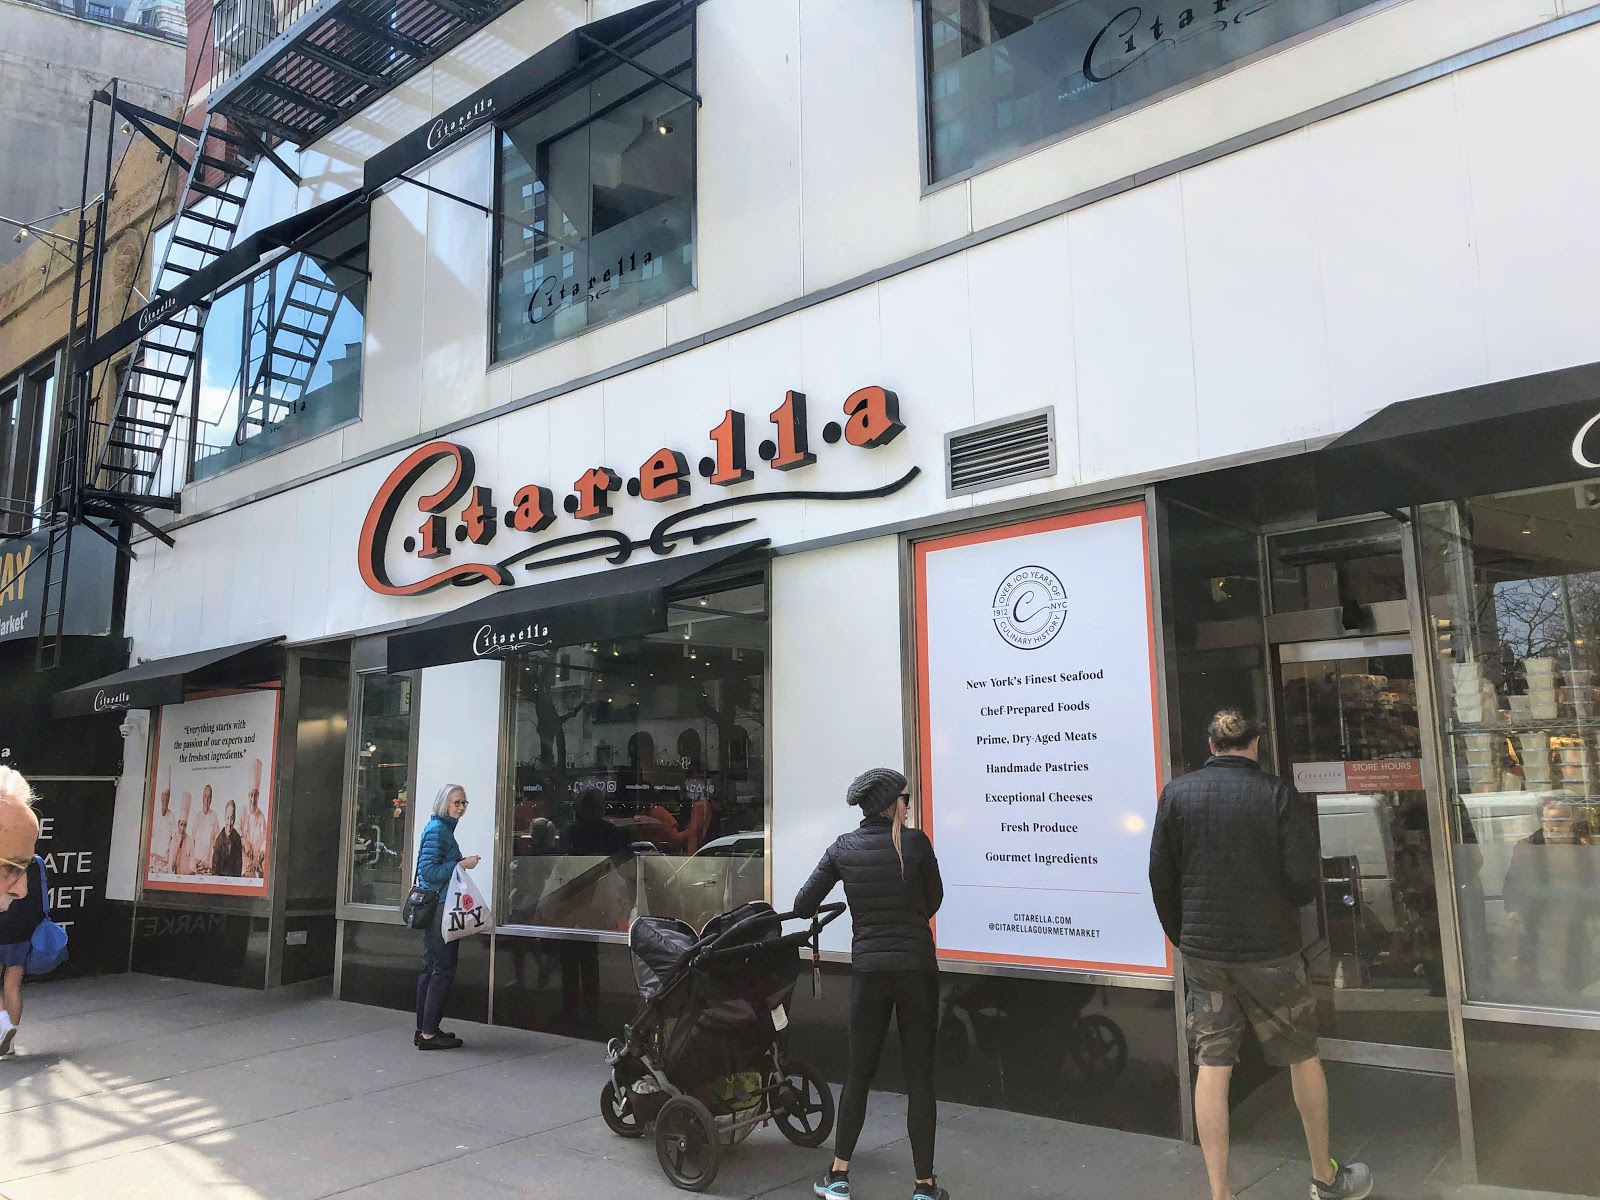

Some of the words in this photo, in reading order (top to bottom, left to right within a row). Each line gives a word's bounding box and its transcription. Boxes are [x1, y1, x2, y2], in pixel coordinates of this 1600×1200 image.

[427, 98, 494, 150] Citarella
[528, 250, 653, 324] Citarella
[0, 545, 32, 605] AY
[998, 582, 1013, 604] OVER
[1013, 571, 1028, 583] 100
[1030, 571, 1053, 587] YEARS
[1051, 585, 1061, 597] OF
[993, 608, 1008, 617] 1912
[1050, 601, 1068, 610] NYC
[1000, 621, 1033, 645] CULINARY
[1033, 614, 1061, 644] HISTORY
[473, 624, 549, 656] Citarella
[966, 680, 988, 690] New
[1024, 673, 1057, 685] Finest
[1059, 668, 1104, 683] Seafood
[980, 702, 1055, 717] Chef-Prepared
[1057, 700, 1090, 712] Foods
[215, 722, 232, 732] starts
[233, 719, 246, 730] with
[174, 740, 182, 750] the
[183, 738, 203, 751] passion
[204, 737, 210, 747] of
[210, 738, 221, 746] our
[222, 736, 243, 748] experts
[244, 733, 256, 743] and
[976, 734, 1010, 746] Prime,
[1012, 731, 1061, 746] Dry-Aged
[1064, 730, 1098, 742] Meats
[179, 754, 187, 763] the
[188, 752, 210, 763] freshest
[986, 762, 1042, 774] Handmade
[1044, 760, 1089, 772] Pastries
[1352, 763, 1378, 772] STORE
[1381, 762, 1412, 771] HOURS
[985, 791, 1046, 806] Exceptional
[1048, 791, 1093, 803] Cheeses
[1000, 821, 1030, 833] Fresh
[1032, 821, 1079, 833] Produce
[985, 851, 1032, 864] Gourmet
[1034, 852, 1099, 867] Ingredients
[453, 892, 462, 911] I
[448, 906, 484, 932] NY
[1013, 913, 1072, 925] CITARELLA.COM
[988, 922, 1101, 938] @CITARELLAGOURMETMARKET
